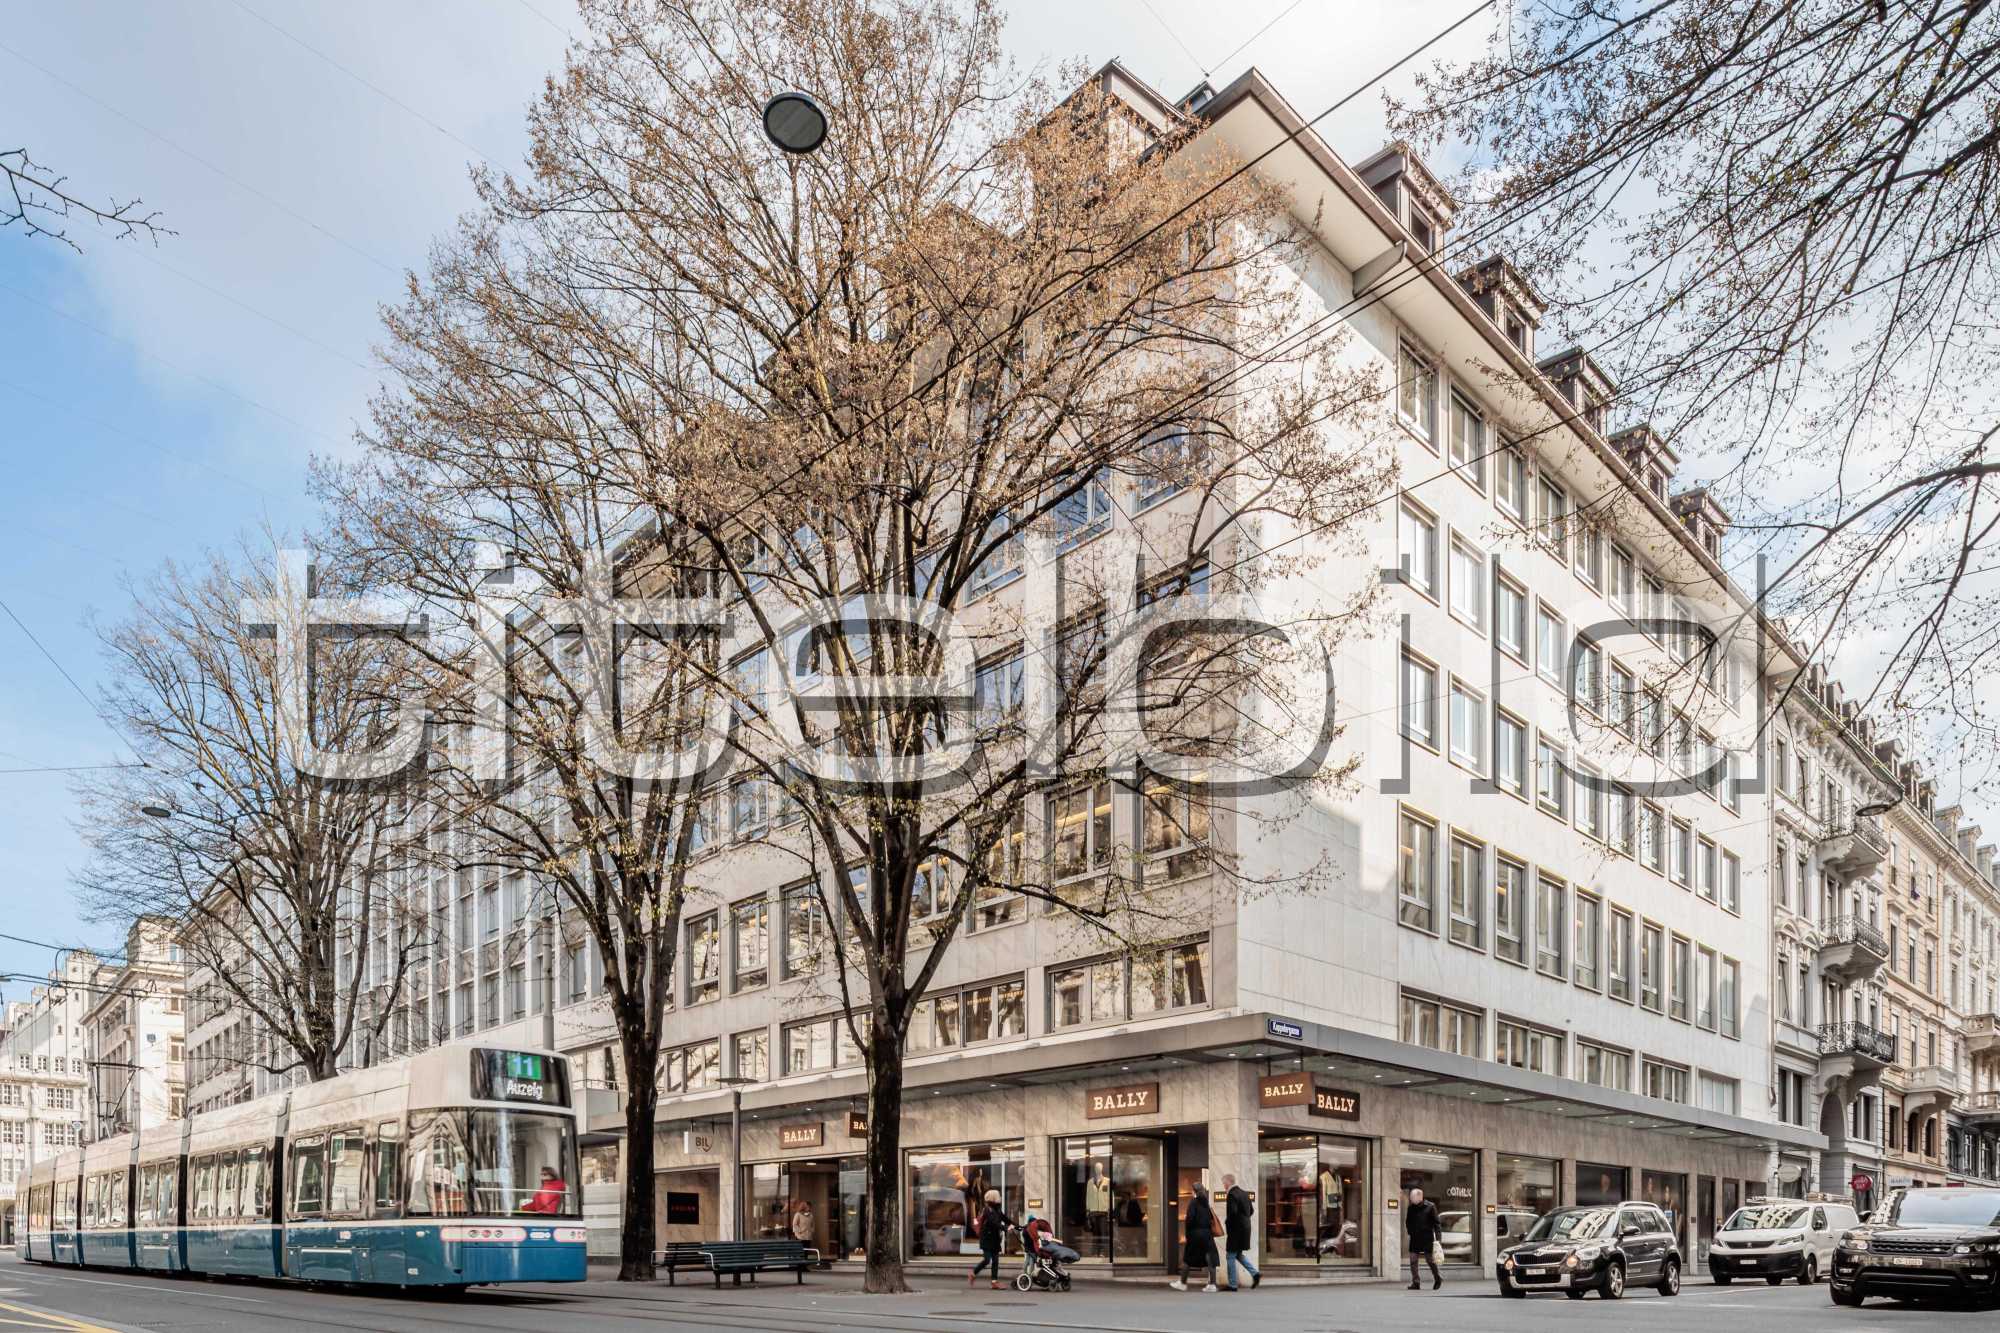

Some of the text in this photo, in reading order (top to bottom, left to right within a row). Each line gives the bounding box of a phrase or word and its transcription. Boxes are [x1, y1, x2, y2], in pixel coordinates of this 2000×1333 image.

[513, 1056, 533, 1077] 11
[1265, 1084, 1303, 1097] BALLY
[1094, 1091, 1148, 1110] BALLY
[1318, 1094, 1355, 1113] BALLY
[784, 1129, 816, 1142] BALLY
